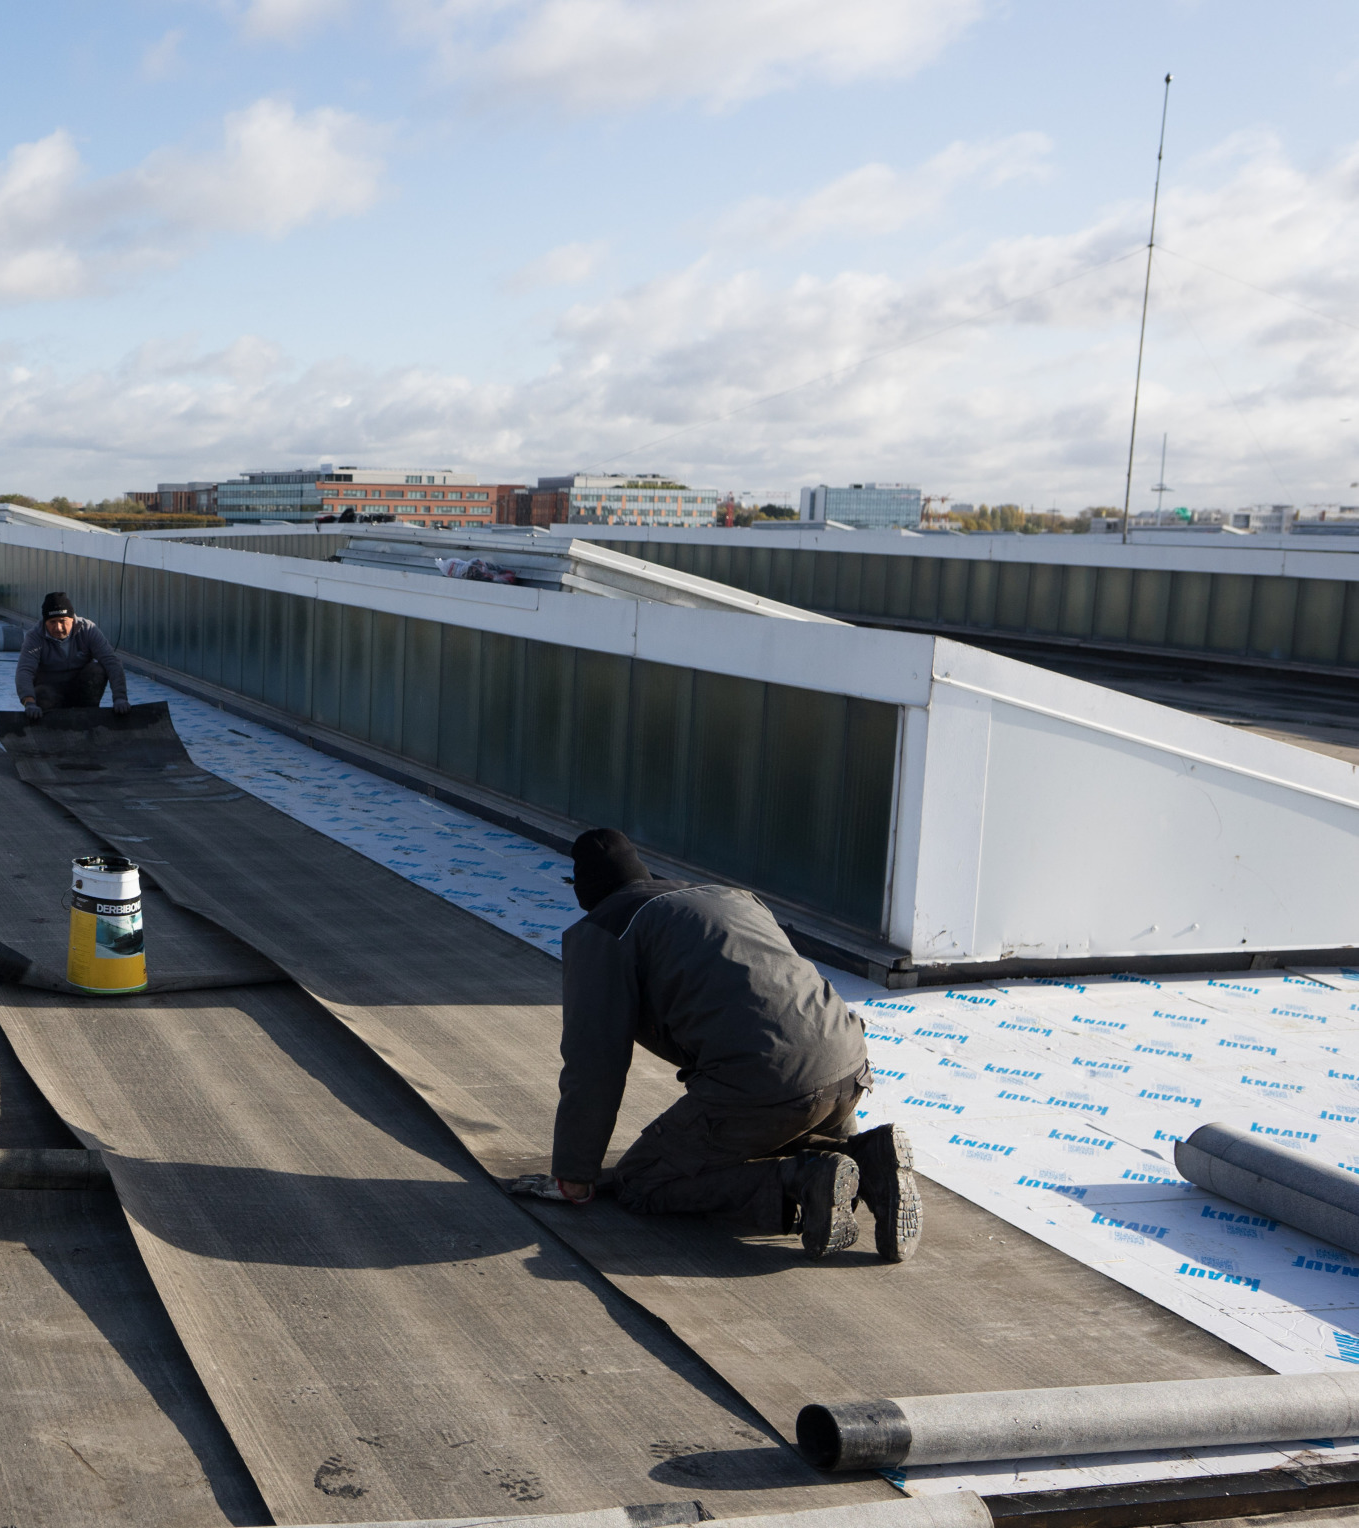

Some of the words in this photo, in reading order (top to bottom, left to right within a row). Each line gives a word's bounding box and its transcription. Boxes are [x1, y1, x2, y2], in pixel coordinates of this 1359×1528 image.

[1207, 979, 1261, 995] KNAUF
[864, 998, 918, 1014] KNAUF
[945, 990, 999, 1006] KNAUF
[1071, 1014, 1129, 1030] KNAUF
[1153, 1010, 1210, 1025] KNAUF
[1270, 1007, 1327, 1024] KNAUF
[913, 1027, 969, 1044] KNAUF
[997, 1021, 1053, 1037] KNAUF
[1133, 1044, 1193, 1062] KNAUF
[1216, 1039, 1278, 1056] KNAUF
[984, 1063, 1045, 1080] KNAUF
[1071, 1056, 1134, 1073] KNAUF
[900, 1096, 966, 1115] KNAUF
[1046, 1096, 1109, 1116] KNAUF
[1137, 1089, 1202, 1108] KNAUF
[1048, 1129, 1118, 1150] KNAUF
[1250, 1122, 1321, 1143] KNAUF
[948, 1134, 1018, 1156] KNAUF
[1013, 1175, 1088, 1200] KNAUF
[1118, 1169, 1195, 1193] KNAUF
[1091, 1212, 1171, 1239] KNAUF
[1200, 1205, 1281, 1232] KNAUF
[1174, 1263, 1262, 1293] KNAUF
